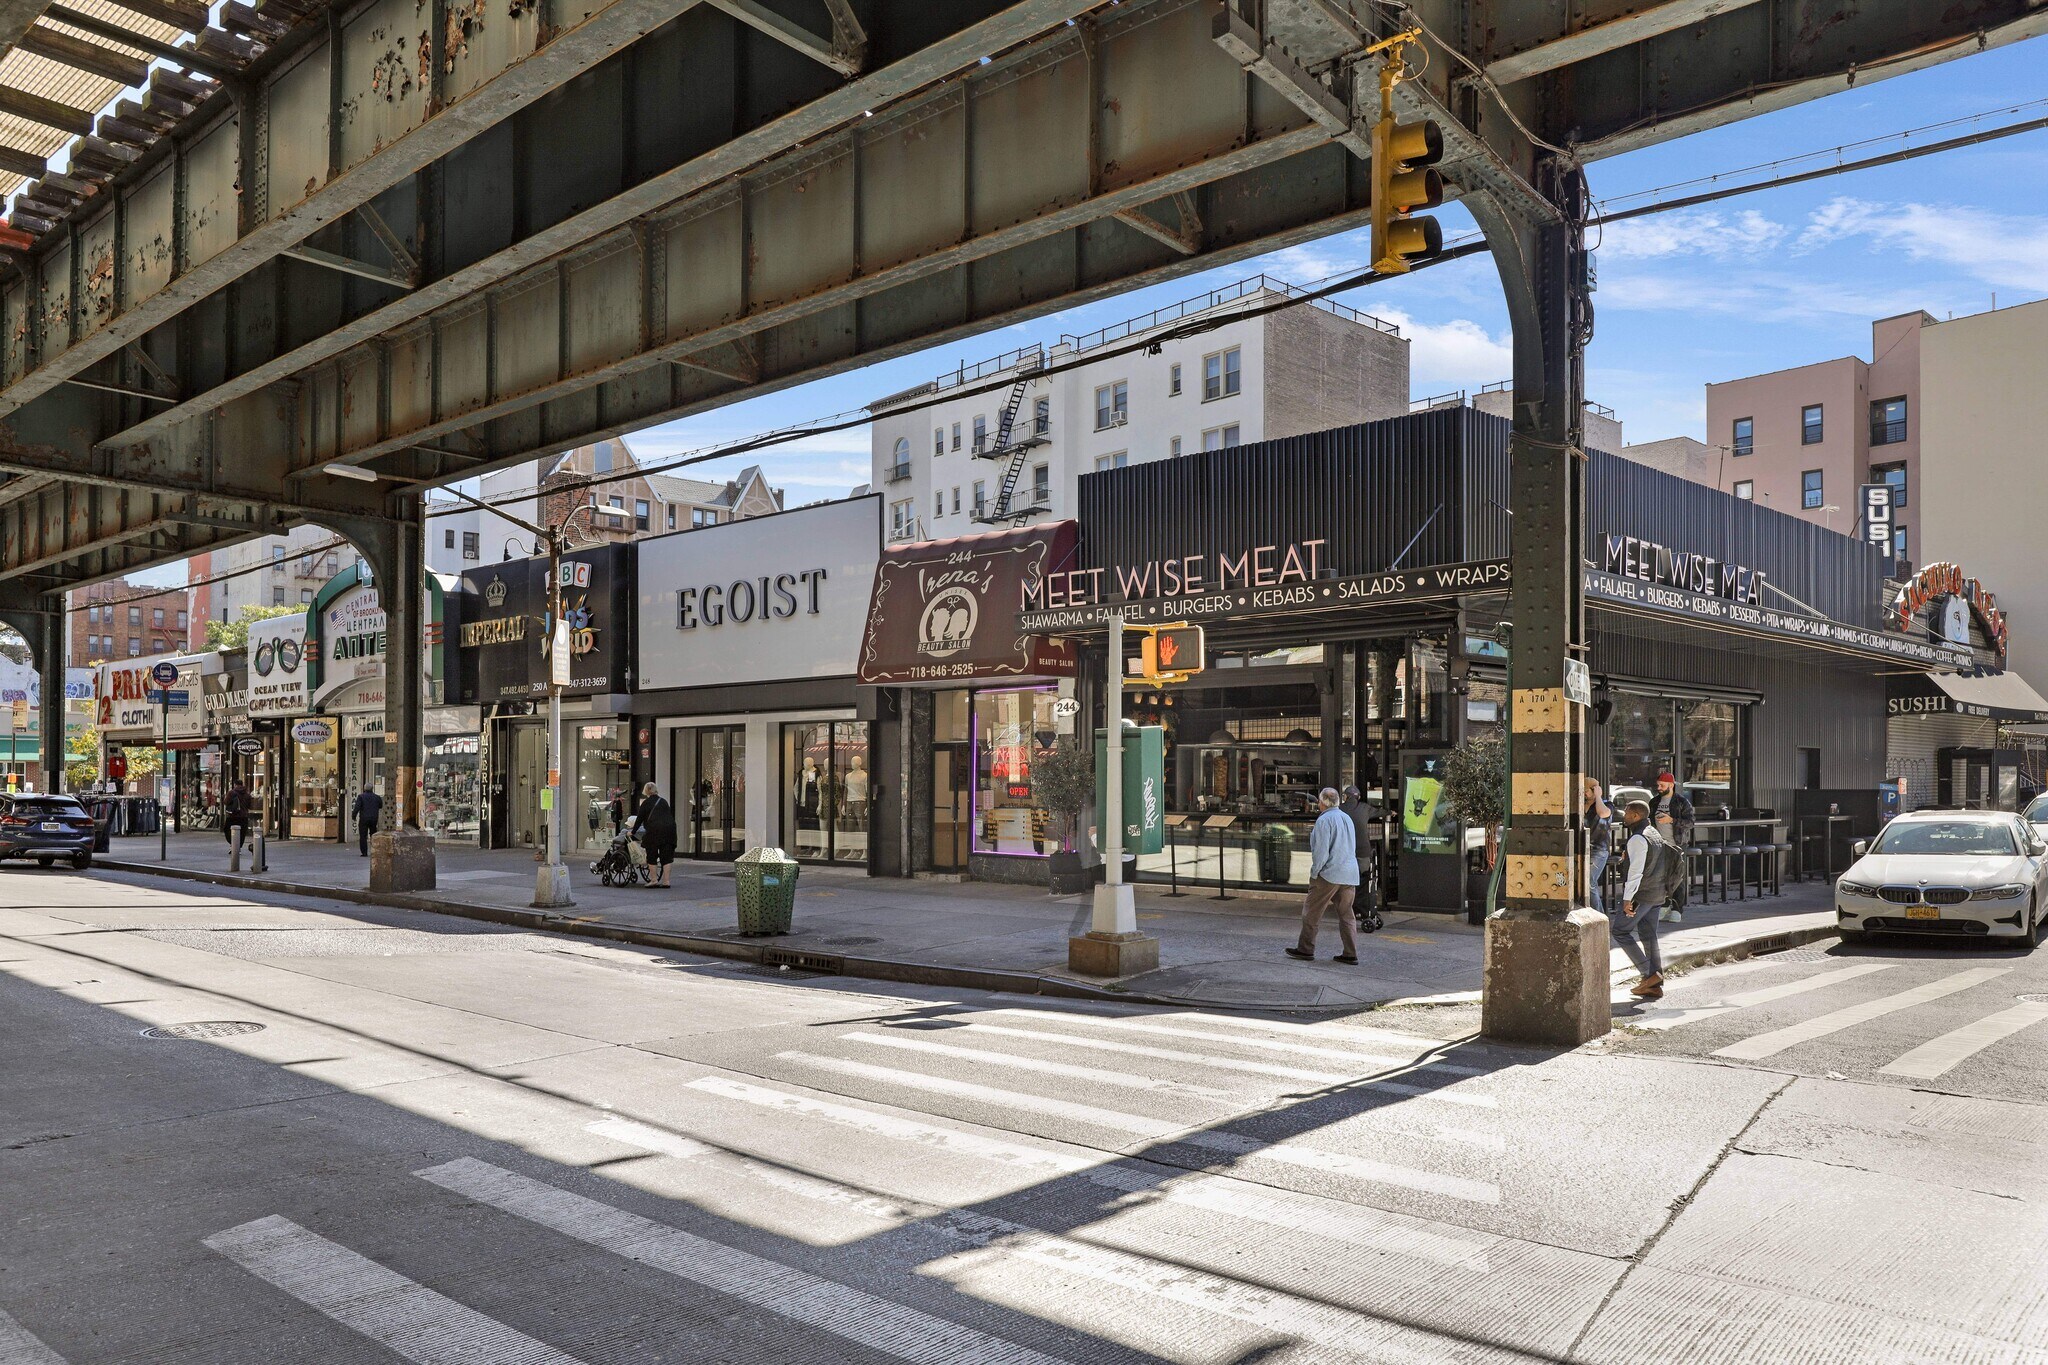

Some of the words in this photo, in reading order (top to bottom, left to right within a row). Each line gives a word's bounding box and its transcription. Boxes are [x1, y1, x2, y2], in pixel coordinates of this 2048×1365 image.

[948, 550, 972, 564] 244
[1021, 568, 1104, 611] MEET
[1116, 555, 1205, 599] WISE
[1219, 539, 1325, 590] MEAT
[1606, 533, 1662, 583] MEET
[1669, 548, 1715, 596] WISE
[1721, 562, 1765, 607] MEAT
[345, 592, 377, 615] CENTRAL
[676, 568, 827, 630] EGOIST
[1021, 612, 1083, 630] SHAWARMA
[1096, 604, 1145, 623] FALAFEL
[1163, 595, 1233, 617] BURGERS
[1253, 585, 1315, 608] KEBABS
[1338, 575, 1405, 599] SALADS
[1436, 562, 1510, 588] WRAPS
[1600, 576, 1637, 600] FALAFEL
[1647, 587, 1684, 609] BURGERS
[1692, 596, 1720, 616] KEBABS
[1729, 605, 1760, 625] DESSERTS
[1766, 612, 1780, 628] PITA
[1783, 616, 1806, 633] WRAPS
[1809, 621, 1830, 637] SALADS
[1834, 626, 1857, 643] HUMMUS
[1860, 632, 1869, 646] ICE
[1869, 634, 1886, 650] CREAM
[1904, 642, 1918, 656] SOUPS
[1935, 649, 1953, 663] COFFEE
[460, 615, 526, 648] IMPERIAL
[917, 641, 944, 652] BEAUTY
[948, 639, 971, 650] SALON
[1039, 658, 1057, 666] BEAUTY
[910, 663, 974, 678] 718-646-2525
[254, 684, 278, 695] OCEAN
[281, 682, 302, 692] VIEW
[532, 682, 543, 692] 250
[205, 693, 226, 711] GOLD
[249, 695, 303, 712] OPTICAL
[1531, 694, 1545, 703] 170
[1888, 695, 1947, 713] SUSHI
[1057, 702, 1076, 712] 244
[296, 720, 330, 731] PHARMACY
[481, 718, 489, 820] IMPERIAL
[1009, 786, 1029, 796] OPEN
[1888, 792, 1896, 803] P
